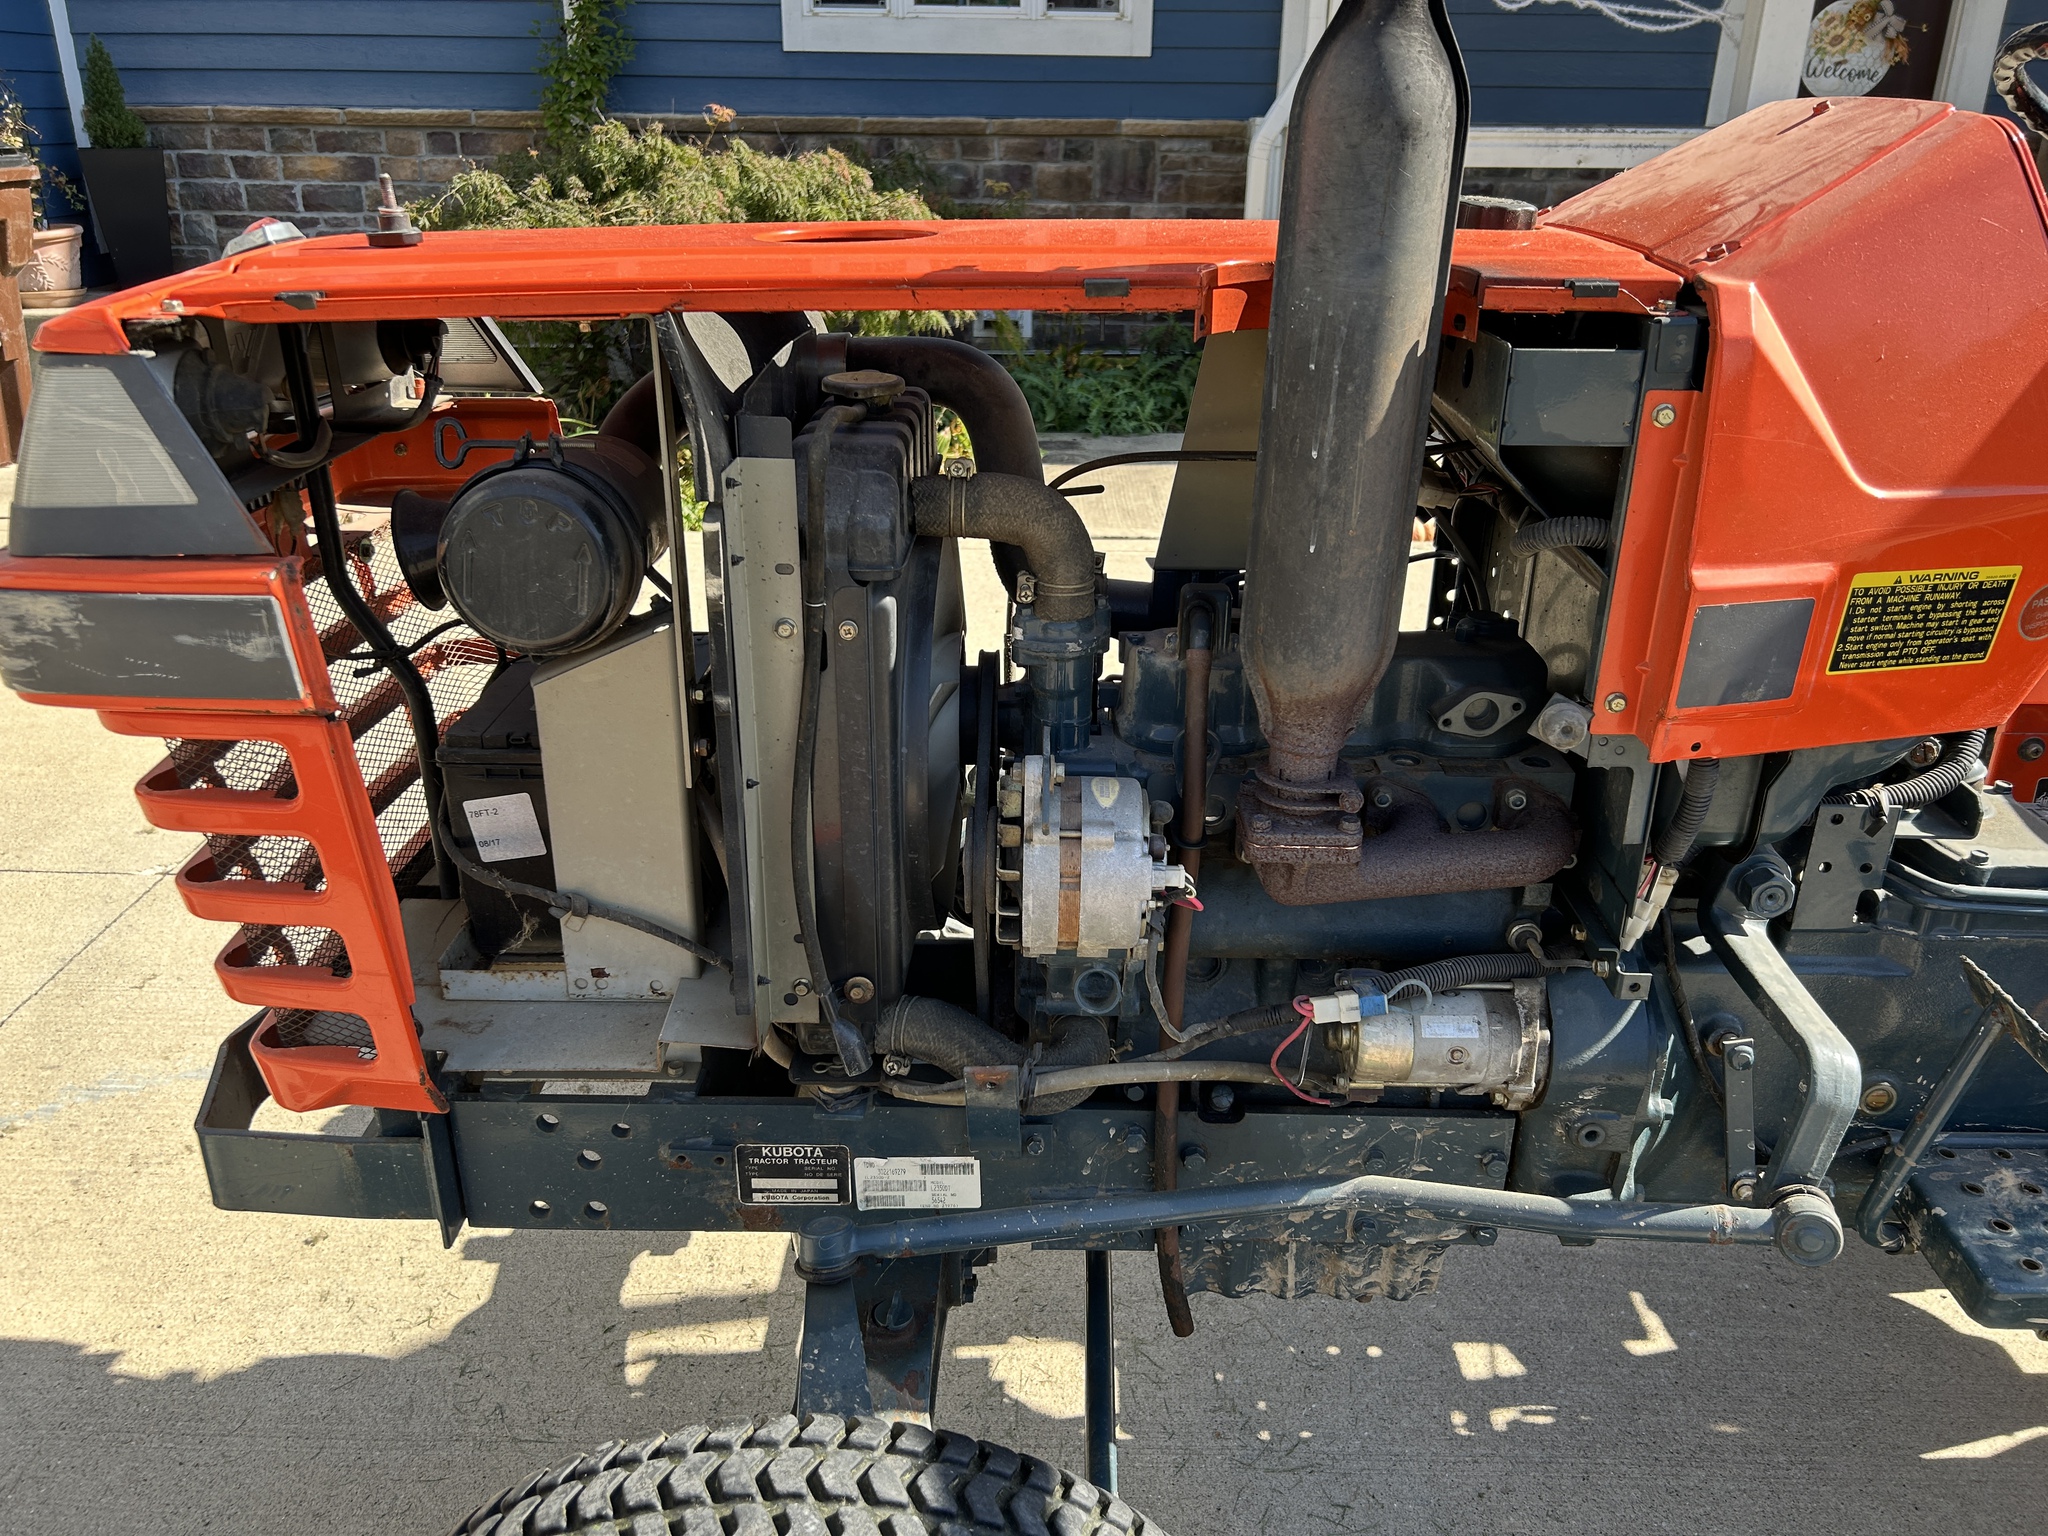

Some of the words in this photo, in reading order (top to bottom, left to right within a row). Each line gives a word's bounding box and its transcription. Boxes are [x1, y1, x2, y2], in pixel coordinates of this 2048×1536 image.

[1806, 56, 1882, 83] Welcome
[1909, 571, 1980, 583] WARNING
[1854, 588, 1865, 596] TO
[1868, 586, 1892, 596] AVOID
[1895, 584, 1934, 594] POSSIBLE
[1936, 582, 1965, 591] INJURY
[1968, 581, 1980, 590] OR
[1982, 580, 2008, 589] DEATH
[1850, 596, 1874, 606] FROM
[1876, 596, 1883, 604] A
[1886, 593, 1922, 604] MACHINE
[1924, 591, 1961, 601] RUNAWAY.
[1869, 606, 1883, 614] not
[1886, 604, 1905, 613] start
[1910, 603, 1932, 613] engine
[1936, 602, 1946, 611] by
[1950, 600, 1979, 609] shorting
[1982, 599, 2006, 607] across
[1852, 615, 1879, 624] starter
[1882, 613, 1914, 622] terminals
[1928, 609, 1962, 620] bypassing
[1965, 608, 1977, 616] the
[1980, 607, 2002, 616] safety
[1850, 624, 1868, 633] start
[1870, 623, 1894, 632] switch.
[1896, 621, 1924, 630] Machine
[1926, 621, 1939, 629] may
[1941, 618, 1960, 627] start
[1968, 618, 1985, 627] gear
[1986, 616, 2000, 624] and
[1847, 634, 1865, 642] move
[1866, 632, 1874, 641] if
[1874, 631, 1897, 640] normal
[1897, 630, 1925, 639] starting
[1925, 627, 1955, 637] circuitry
[1955, 626, 1962, 634] is
[1963, 625, 1995, 635] bypassed.
[1865, 641, 1888, 651] engine
[1889, 640, 1904, 649] only
[1906, 638, 1922, 647] from
[1924, 636, 1958, 646] operator's
[1960, 635, 1976, 643] seat
[1978, 633, 1992, 641] with
[1838, 661, 1858, 670] Never
[1859, 660, 1876, 668] start
[1876, 658, 1897, 668] engine
[1898, 656, 1913, 665] while
[1915, 654, 1941, 664] standing
[1951, 652, 1962, 660] the
[1962, 651, 1985, 661] ground.
[1841, 651, 1885, 660] transmission
[1886, 649, 1900, 657] and
[1901, 647, 1918, 656] PTO
[1920, 646, 1937, 654] OFF.
[468, 808, 499, 818] 78FT-2
[761, 1146, 824, 1158] KUBOTA
